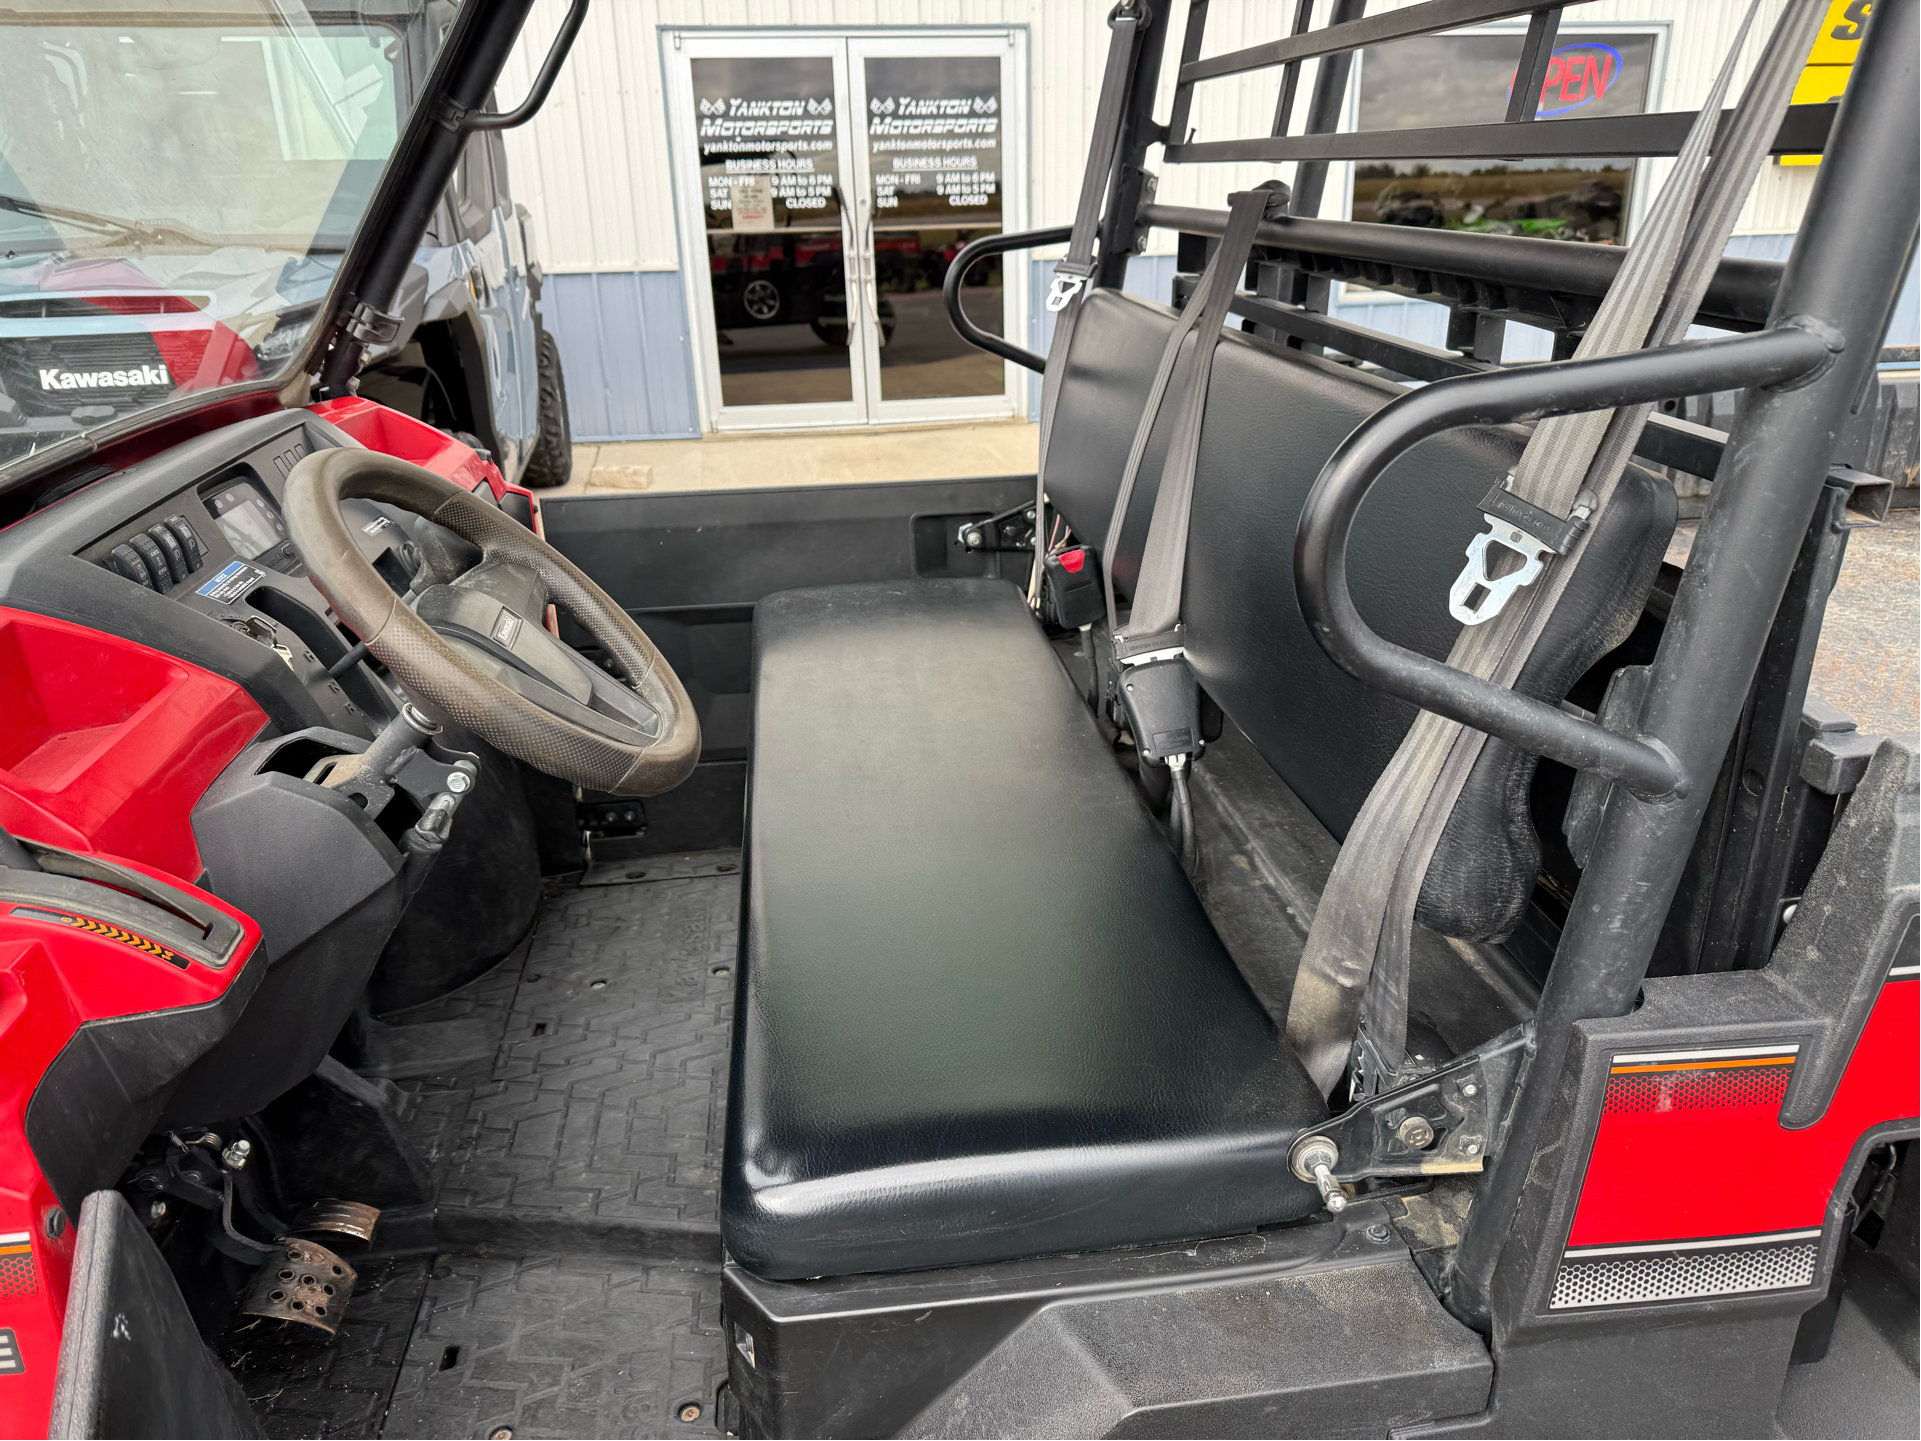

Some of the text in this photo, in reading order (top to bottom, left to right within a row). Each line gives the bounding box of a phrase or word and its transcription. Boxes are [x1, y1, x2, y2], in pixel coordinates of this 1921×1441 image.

[1509, 54, 1612, 103] PEN
[729, 98, 805, 116] YANKTON
[898, 96, 972, 115] YANKTON
[700, 117, 834, 136] MOTORSPORTS
[869, 116, 998, 135] MOTORSPORTS
[703, 139, 833, 156] yanktonmotorsports.com
[872, 137, 997, 153] yanktonmotorsports.com
[725, 158, 814, 171] BUSINESS HOURS
[892, 155, 978, 169] BUSINESS HOURS
[708, 176, 732, 188] MON
[738, 175, 755, 187] FRI
[771, 174, 833, 186] 9 AM to 6 PM
[875, 173, 899, 185] MON
[904, 173, 921, 185] FRI
[936, 172, 943, 184] 9
[945, 172, 961, 183] AM
[961, 172, 971, 183] to
[980, 171, 995, 183] PM
[709, 187, 729, 198] SAT
[770, 186, 832, 198] 9 AM to 5 PM
[876, 185, 896, 196] SAT
[936, 184, 944, 195] 9
[945, 184, 961, 195] AM
[961, 183, 971, 195] to
[980, 183, 996, 194] PM
[710, 199, 732, 210] SUN
[785, 197, 826, 209] CLOSED
[876, 196, 899, 208] SUN
[949, 194, 988, 206] CLOSED
[39, 364, 170, 390] Kawasaki
[161, 950, 174, 960] 14
